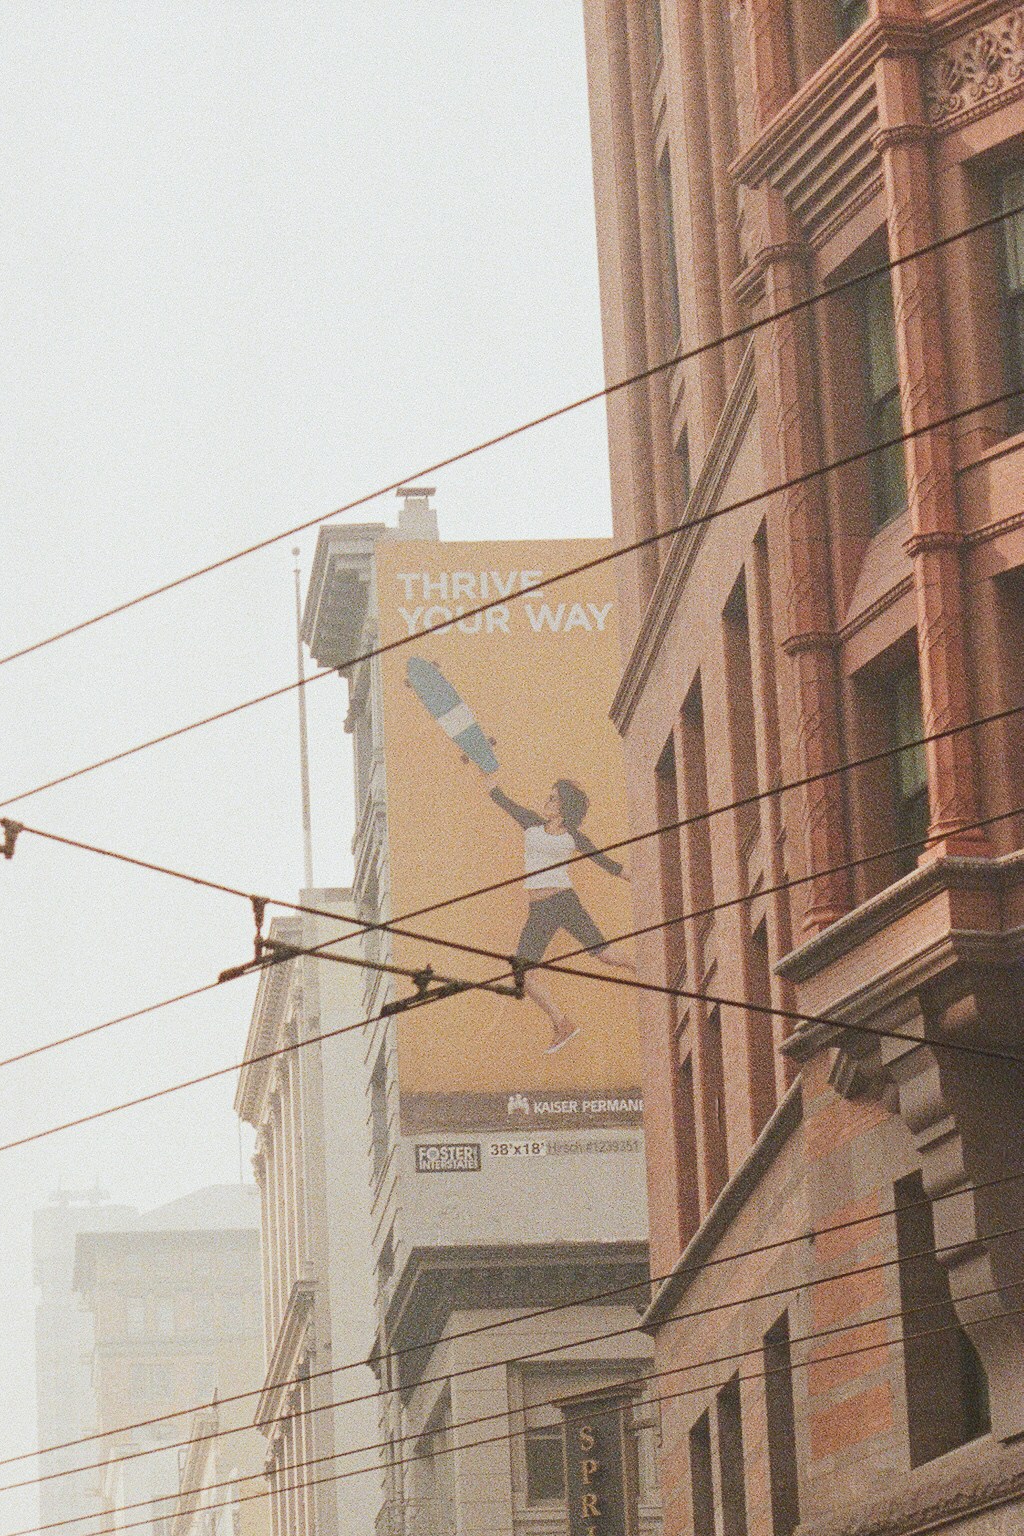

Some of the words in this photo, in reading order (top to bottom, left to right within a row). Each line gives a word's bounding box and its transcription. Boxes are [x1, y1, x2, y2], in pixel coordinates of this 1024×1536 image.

[396, 570, 544, 600] THRIVE
[397, 604, 511, 635] YOUR
[525, 603, 614, 632] WAY
[534, 1101, 578, 1114] KAISER
[418, 1146, 474, 1162] FOSTER
